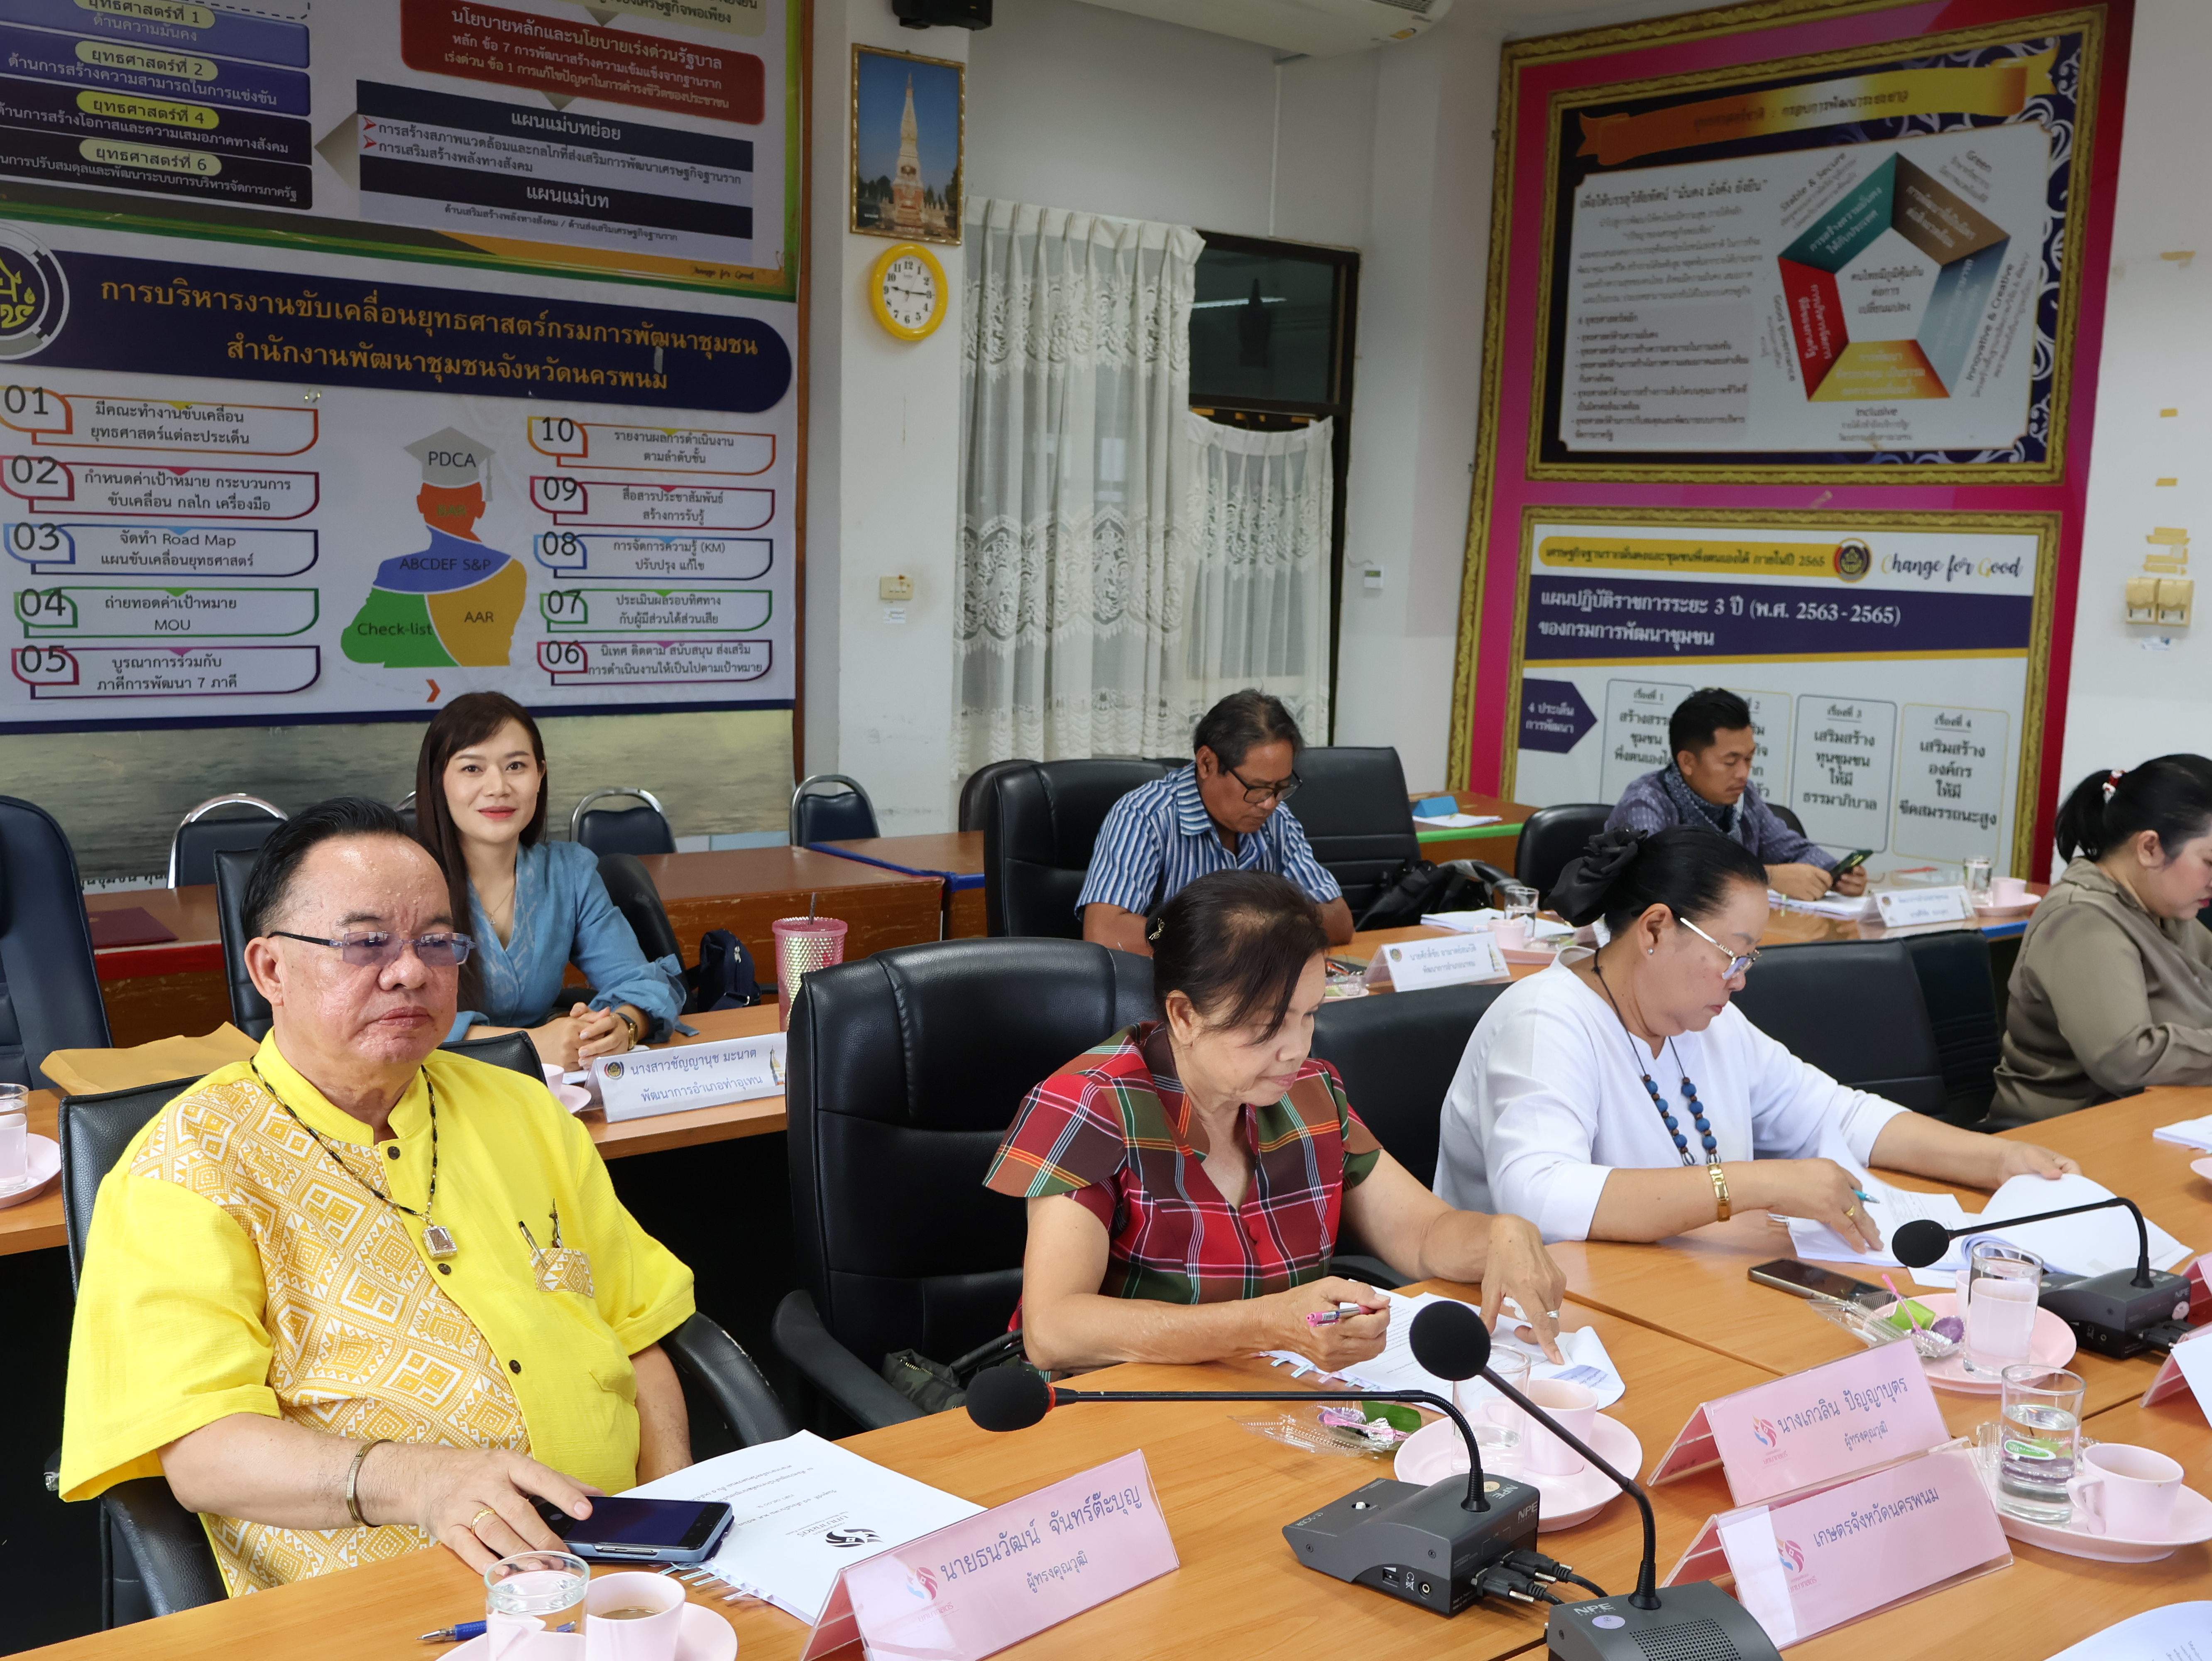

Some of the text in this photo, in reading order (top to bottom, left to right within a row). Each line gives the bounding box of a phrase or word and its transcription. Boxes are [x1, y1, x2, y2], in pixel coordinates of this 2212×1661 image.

[192, 11, 200, 24] 1
[504, 42, 510, 52] 7
[195, 63, 203, 76] 2
[508, 63, 513, 73] 1
[195, 113, 204, 124] 4
[511, 112, 621, 140] แผนแม่บทย่อย
[198, 159, 207, 171] 6
[526, 186, 609, 208] แผนแม่บท
[101, 277, 758, 359] การบริหารงานขับเคลื่อนยุทธศาสตร์กรมการพัฒนาชุมชน
[227, 333, 668, 390] สำนักงานพัฒนาชุมชนจังหวัดนครพนม
[4, 385, 49, 414] 01
[542, 417, 574, 442] 10
[12, 455, 58, 484] 02
[428, 451, 476, 468] PDCA
[216, 478, 291, 491] กระบวนการ
[544, 476, 577, 501] 09
[108, 490, 271, 512] ขับเคลื่อน กลไก เครื่องมือ
[14, 522, 59, 551] 03
[120, 530, 236, 549] จัดทำ Road Map
[543, 531, 576, 556] 08
[701, 542, 725, 554] (KM)
[400, 558, 491, 571] ABCDEF S&P
[1881, 553, 2022, 582] Change for Good
[20, 588, 66, 617] 04
[548, 590, 581, 615] 07
[1714, 599, 1725, 615] 3
[1730, 595, 1744, 616] ปี
[1750, 599, 1789, 619] (พ.ศ.
[154, 620, 191, 631] MOU
[465, 611, 494, 623] AAR
[357, 623, 432, 636] Check-list
[21, 645, 66, 674] 05
[546, 640, 580, 664] 06
[198, 678, 205, 688] 7
[630, 1052, 719, 1076] นางสาวชัญญานุช
[641, 1073, 763, 1103] พัฒนาการอำเภอท่าอุเทน
[1777, 1375, 1908, 1435] นางเกวลิน ปัญญาบุตร
[1844, 1420, 1889, 1451] ผู้ทรงคุณวุฒิ
[1493, 1485, 1518, 1499] NPE
[1518, 1501, 1538, 1521] NPE
[1813, 1487, 1940, 1548] เกษตรจังหวัดนครพนม
[941, 1484, 1143, 1583] นายธนวัฒน์ จันทร์ต๊ะบุญ
[1027, 1551, 1088, 1594] ผู้ทรงคุณวุฒิ
[1573, 1603, 1614, 1614] NPE
